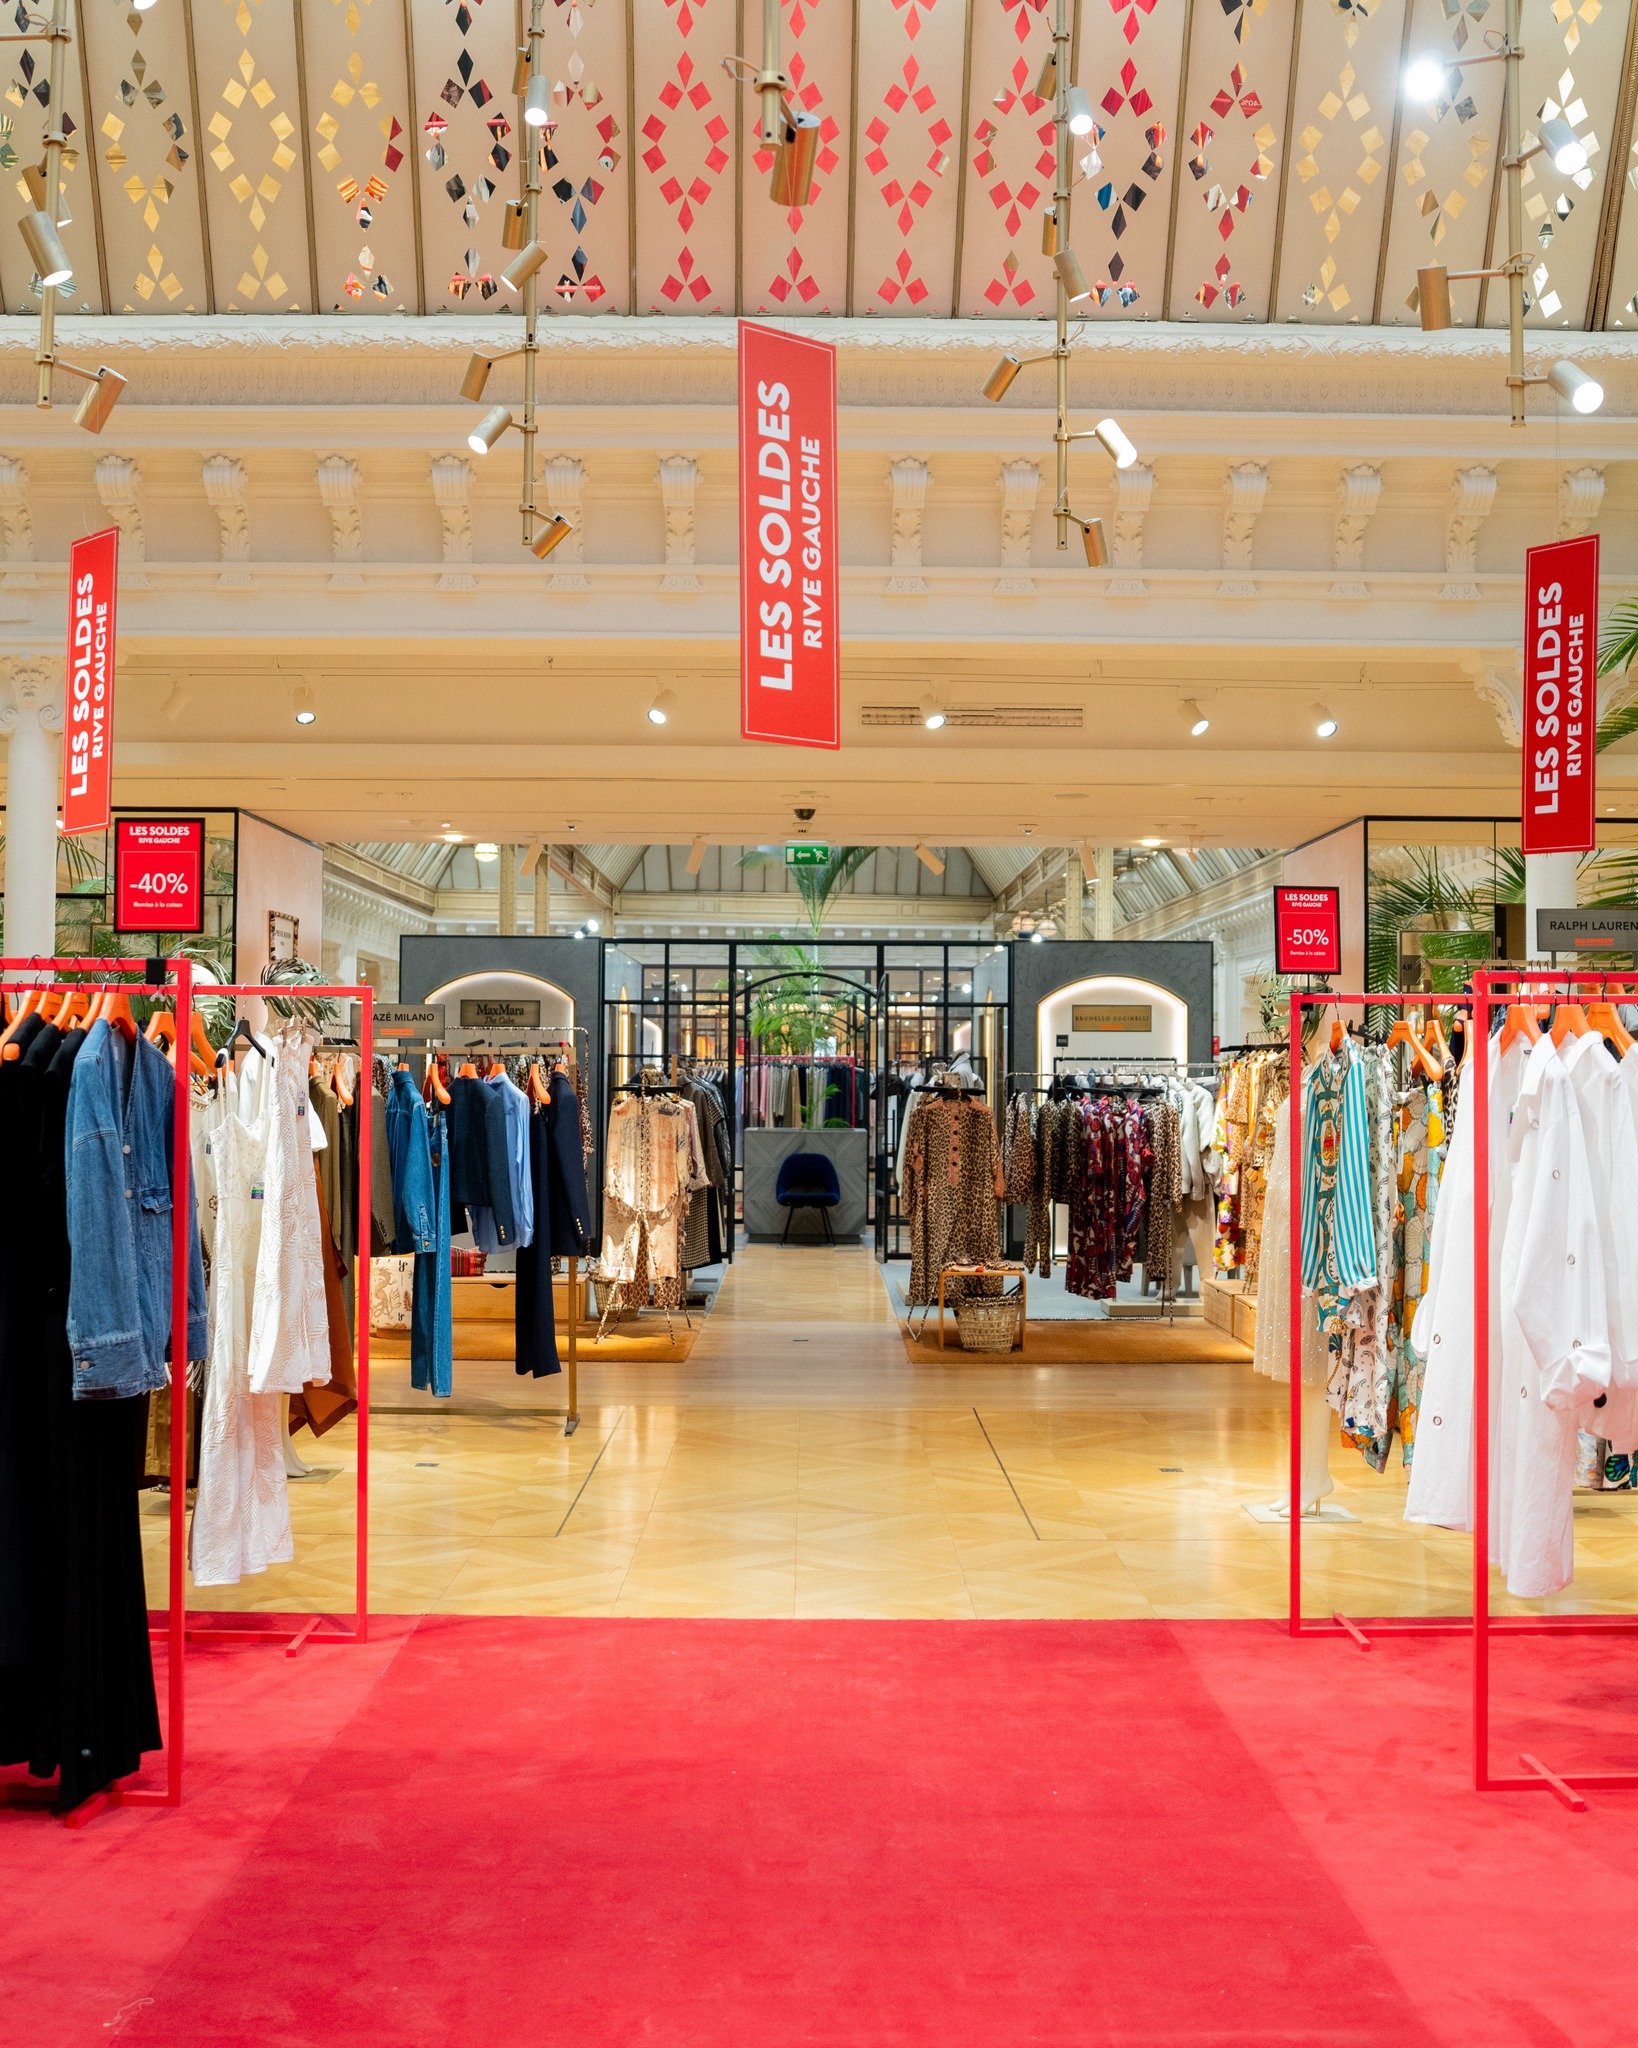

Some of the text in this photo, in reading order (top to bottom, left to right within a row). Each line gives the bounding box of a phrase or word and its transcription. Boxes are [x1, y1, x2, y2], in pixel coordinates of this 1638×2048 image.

[758, 380, 792, 691] LES SOLDES
[801, 436, 822, 648] RIVE GAUCHE
[71, 573, 94, 796] LES SOLDES
[92, 602, 107, 758] RIVE GAUCHE
[1535, 582, 1562, 814] LES SOLDES
[1567, 614, 1583, 775] RIVE GAUCHE
[129, 826, 190, 836] LES SOLDES
[129, 872, 188, 894] -40%
[1285, 893, 1328, 902] LES SOLDES
[1550, 921, 1638, 931] RALPH LAUREN
[1286, 929, 1329, 946] -50%
[373, 1012, 434, 1022] AZÉ MILANO
[476, 1004, 524, 1016] MaxMara
[484, 1016, 497, 1024] The
